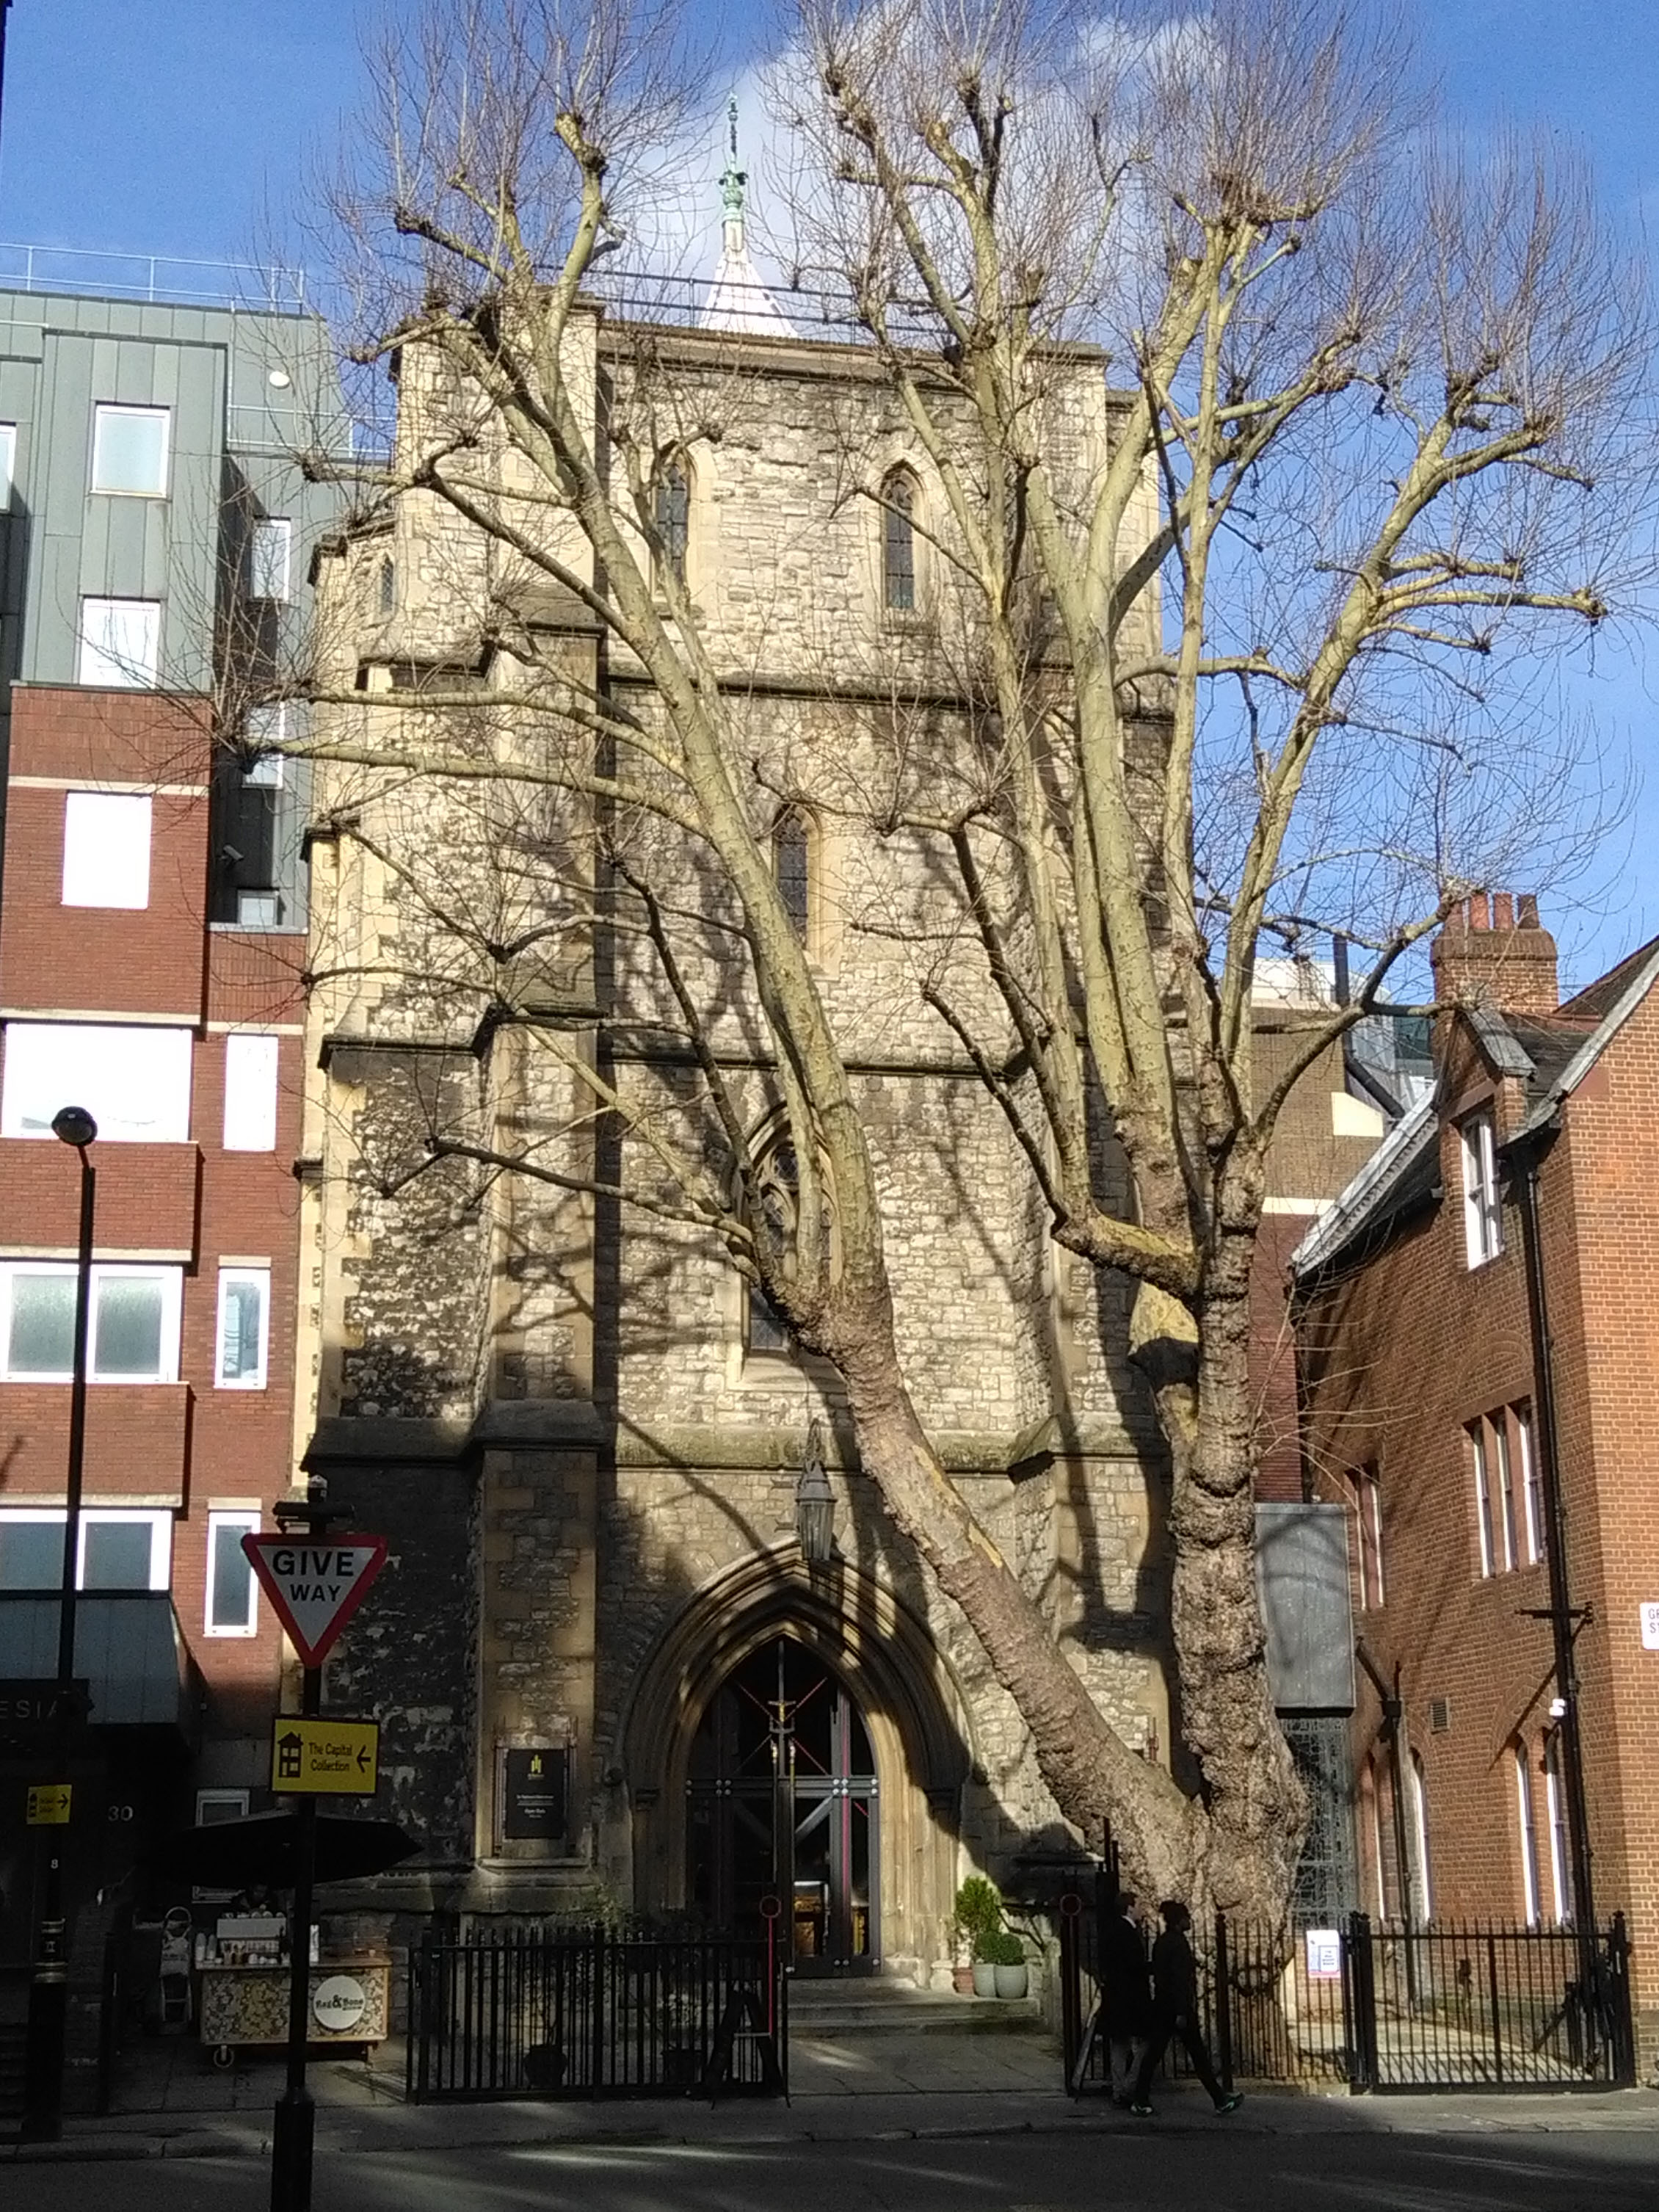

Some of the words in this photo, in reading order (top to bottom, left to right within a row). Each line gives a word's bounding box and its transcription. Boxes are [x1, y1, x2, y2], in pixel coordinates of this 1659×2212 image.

[272, 1550, 354, 1576] GIVE
[290, 1584, 341, 1602] WAY
[1649, 1622, 1659, 1634] S
[308, 1742, 323, 1755] The
[325, 1743, 352, 1758] Capital
[311, 1759, 350, 1772] Collection
[108, 1805, 134, 1821] 30
[333, 1994, 342, 2008] &
